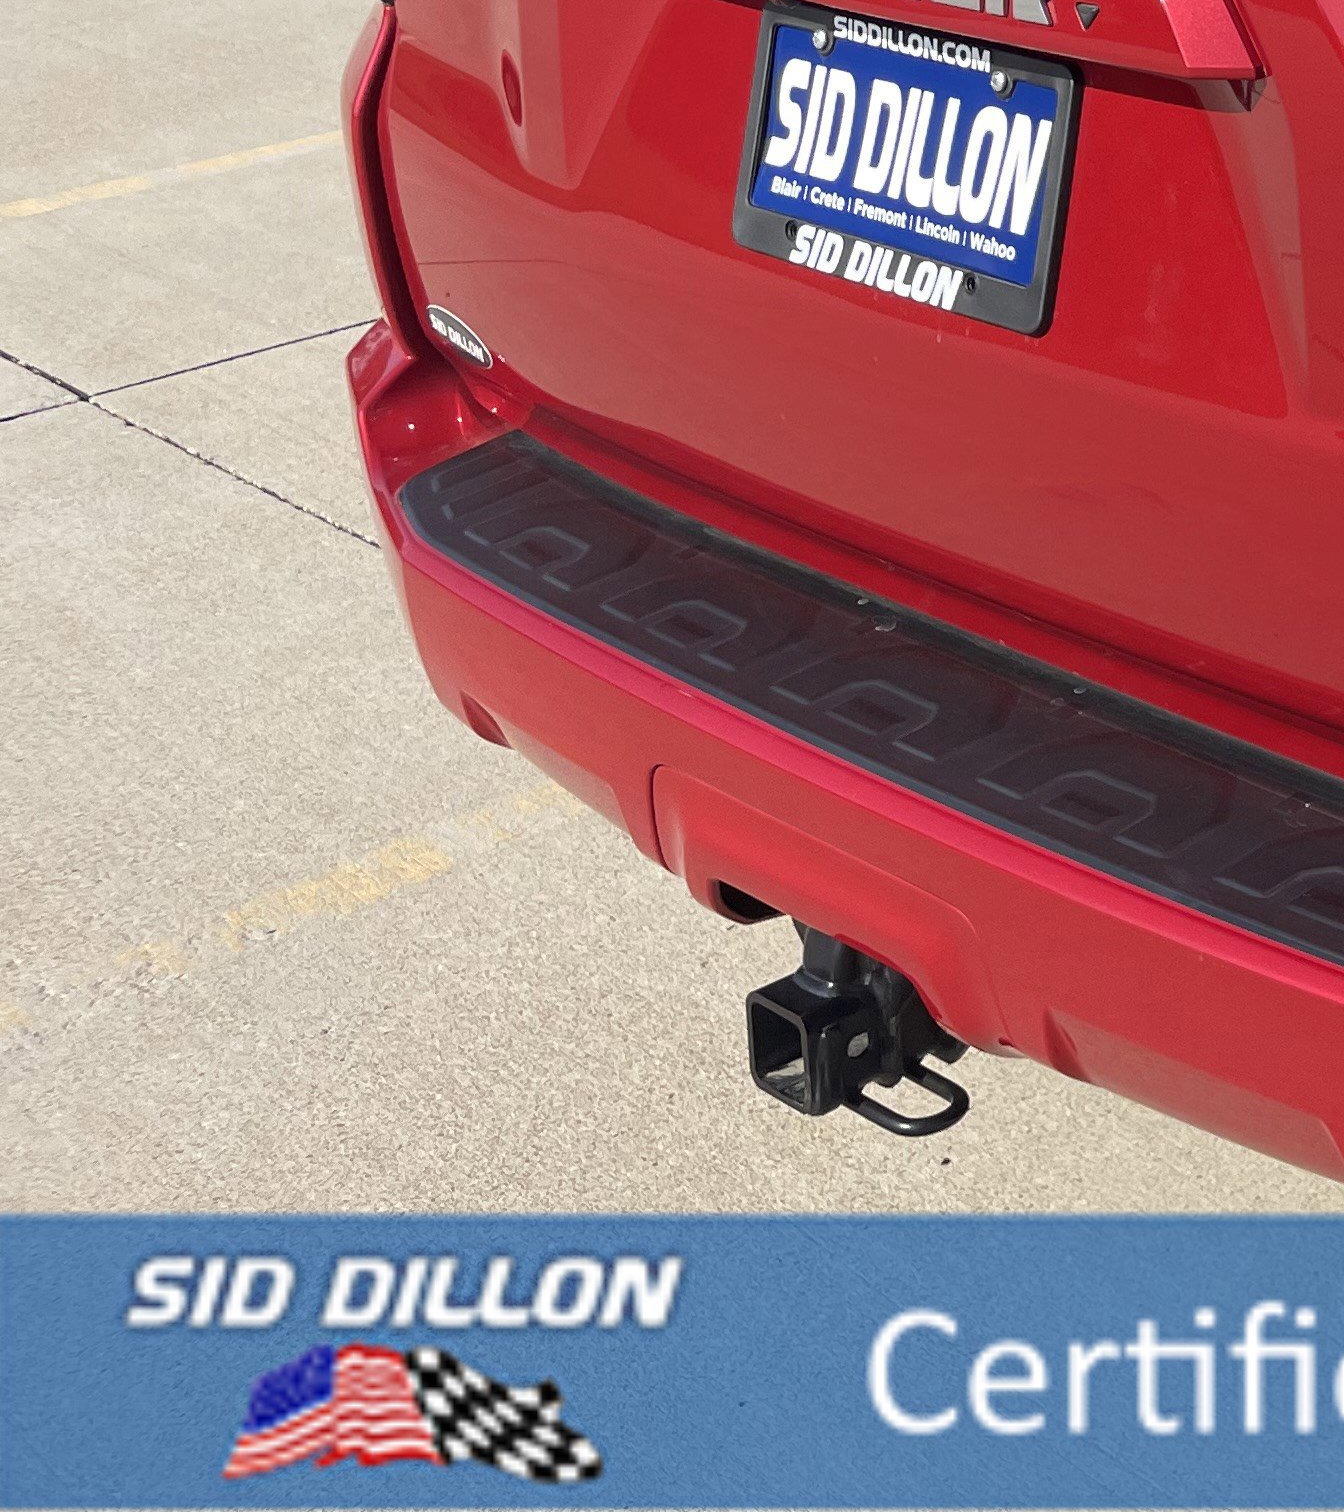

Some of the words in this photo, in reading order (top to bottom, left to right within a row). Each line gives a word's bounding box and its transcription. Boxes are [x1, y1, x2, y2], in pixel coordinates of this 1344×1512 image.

[833, 15, 991, 73] SIDDILLON.COM
[765, 58, 856, 182] SID
[853, 78, 1053, 236] DILLON
[770, 175, 802, 201] Blair
[810, 189, 845, 211] Crete
[853, 199, 908, 229] Fremont
[915, 215, 960, 245] Lincoln
[970, 231, 1017, 262] Wahoo
[789, 224, 844, 274] SID
[844, 239, 964, 311] DILLON
